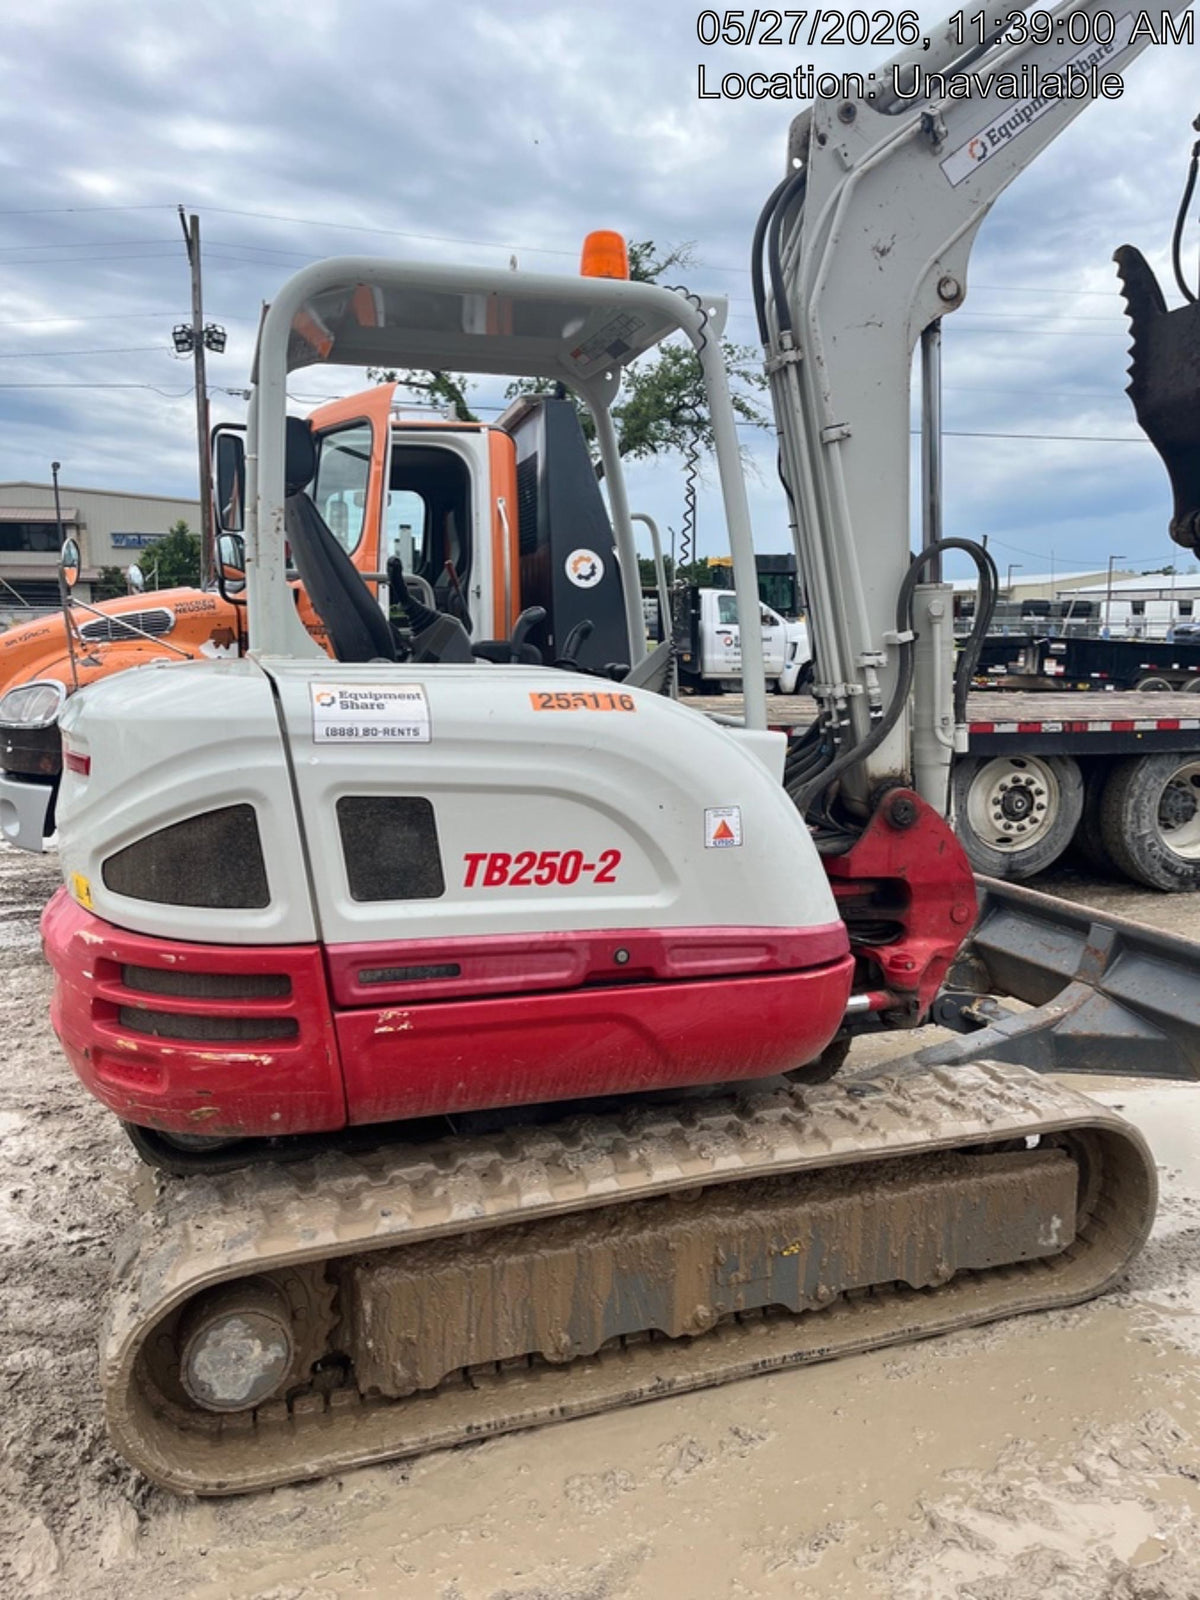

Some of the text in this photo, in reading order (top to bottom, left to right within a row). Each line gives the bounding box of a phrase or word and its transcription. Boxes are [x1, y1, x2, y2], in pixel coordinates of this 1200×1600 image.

[338, 691, 423, 701] Equipment
[340, 700, 385, 710] Share
[538, 692, 634, 711] 255116
[362, 727, 420, 737] 80-RENTS
[463, 849, 621, 887] TB250-2
